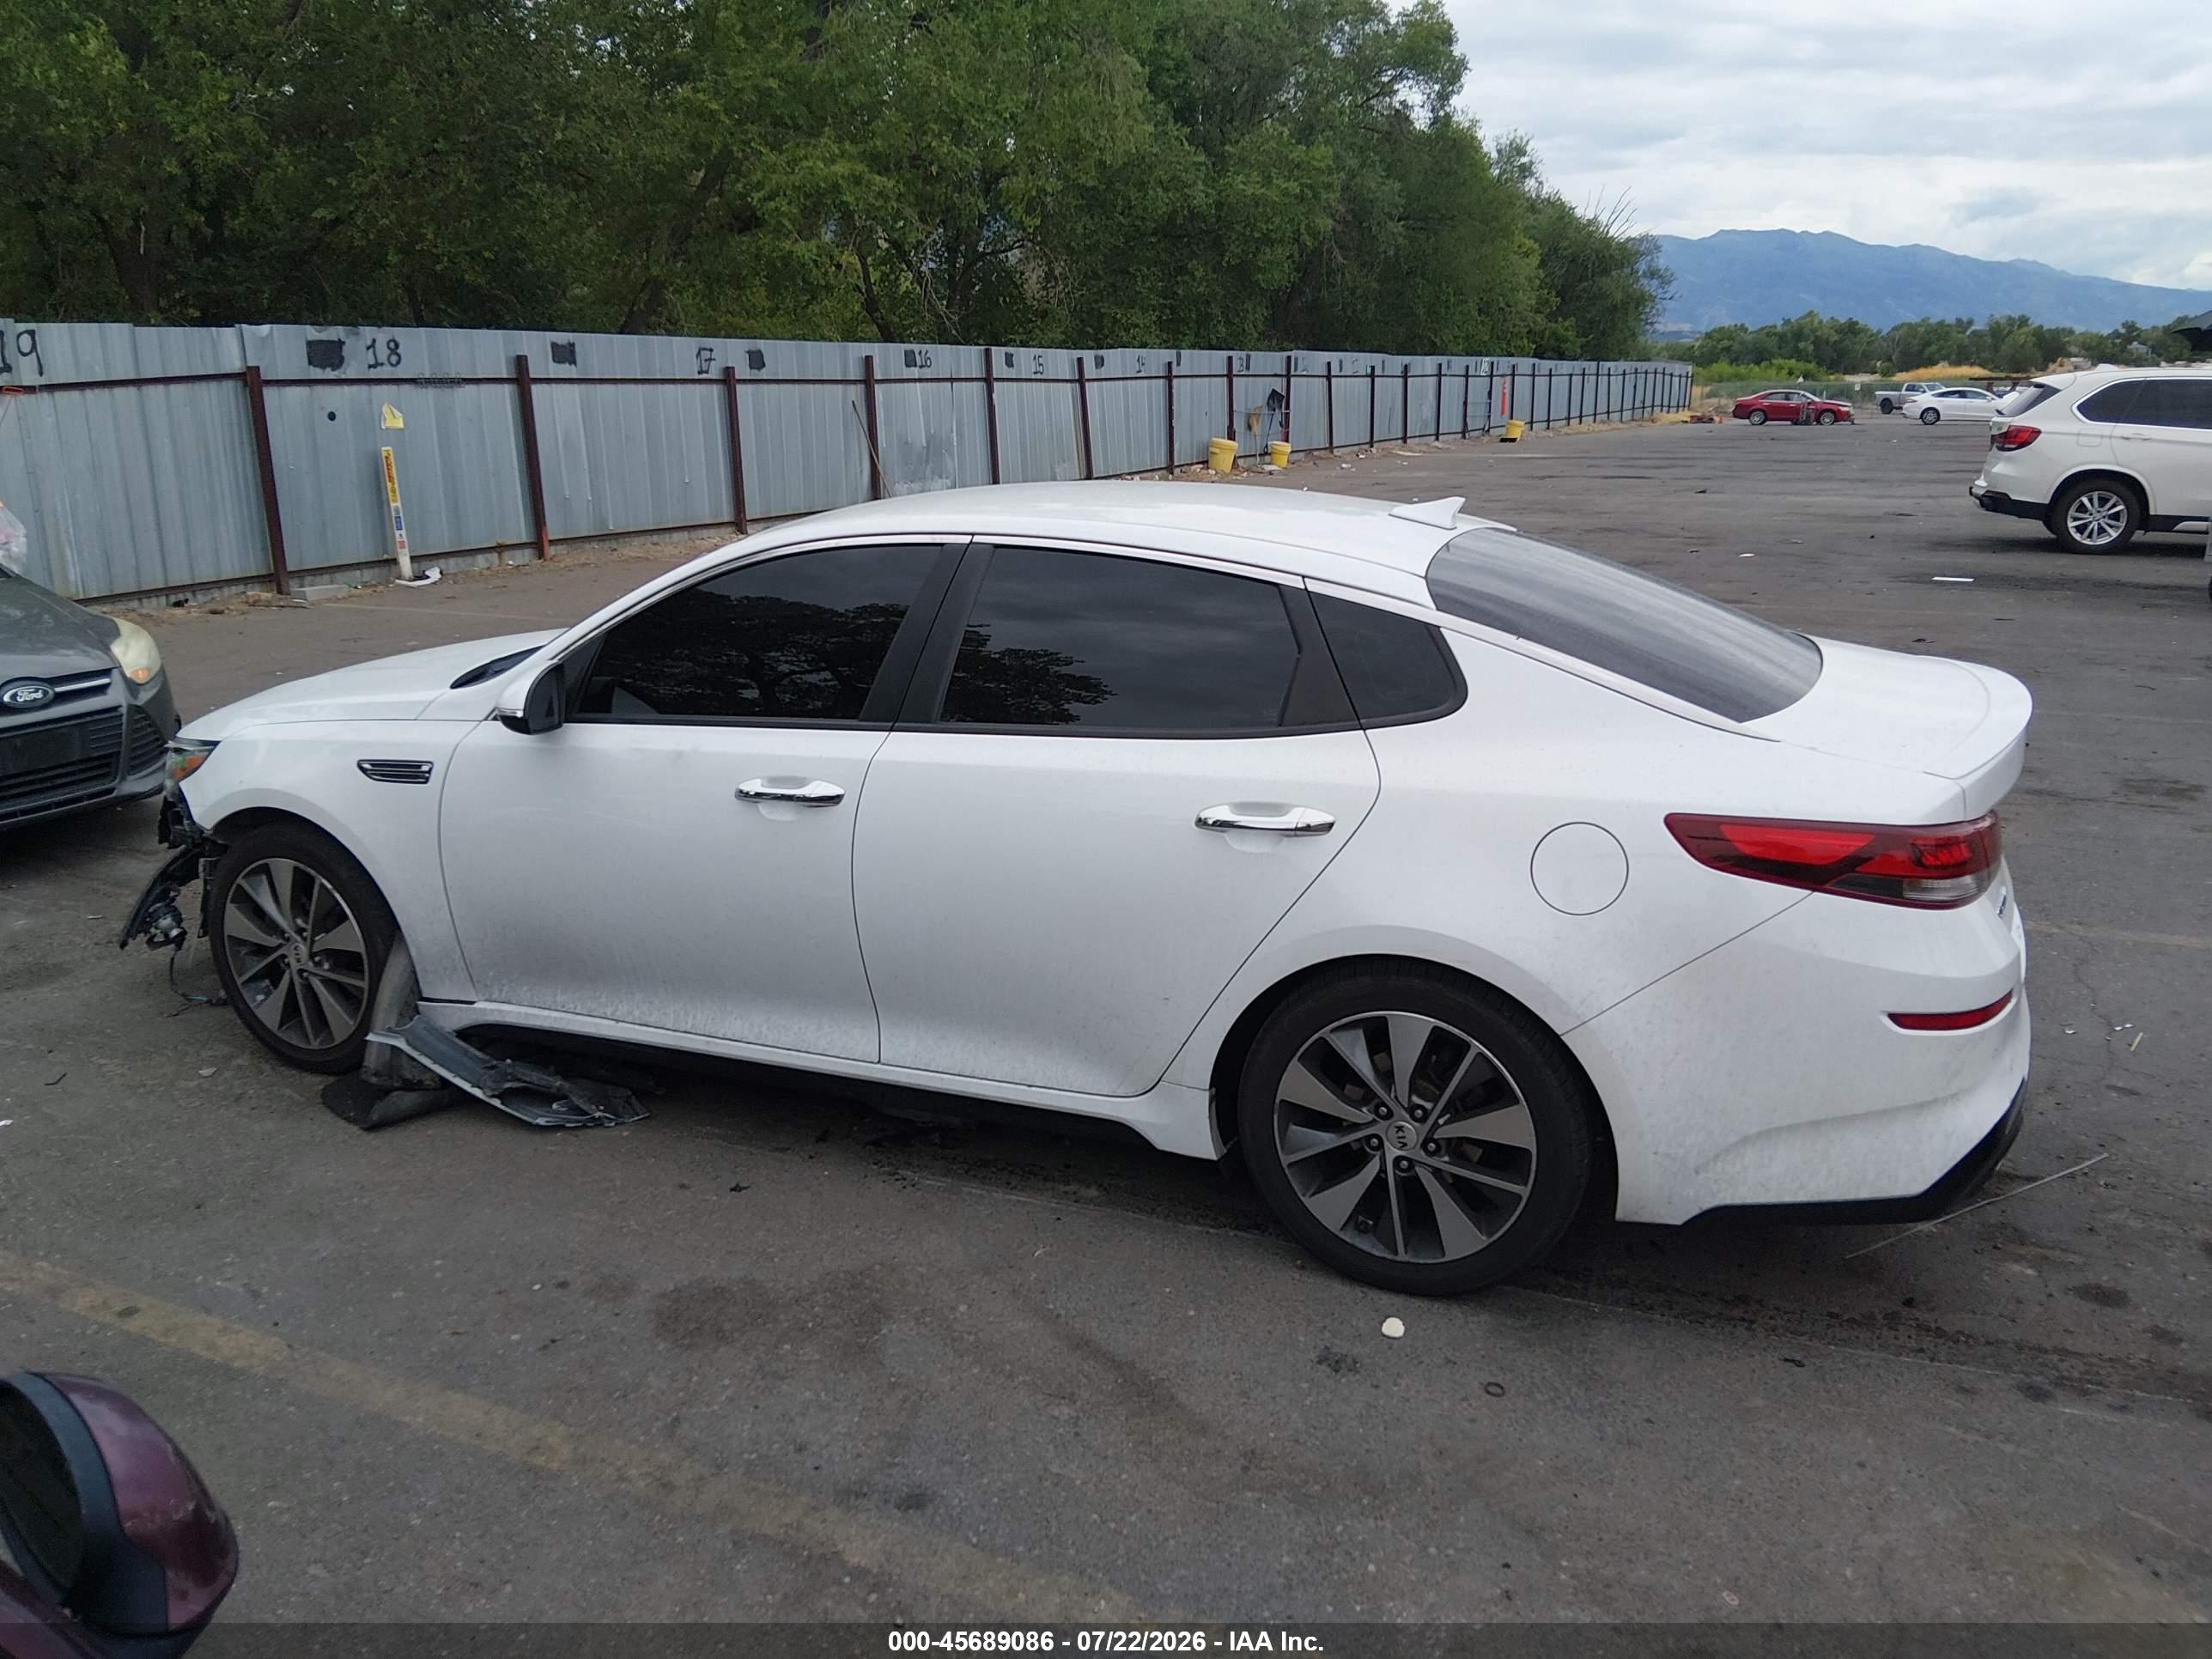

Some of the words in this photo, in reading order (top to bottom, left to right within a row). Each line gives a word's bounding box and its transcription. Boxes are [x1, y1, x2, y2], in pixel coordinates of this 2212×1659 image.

[0, 330, 43, 377] 19
[366, 338, 402, 369] 18
[696, 346, 717, 375] 17
[918, 349, 932, 369] 16
[1032, 355, 1044, 375] 15
[16, 689, 43, 702] Ford
[1394, 1125, 1408, 1149] KIA
